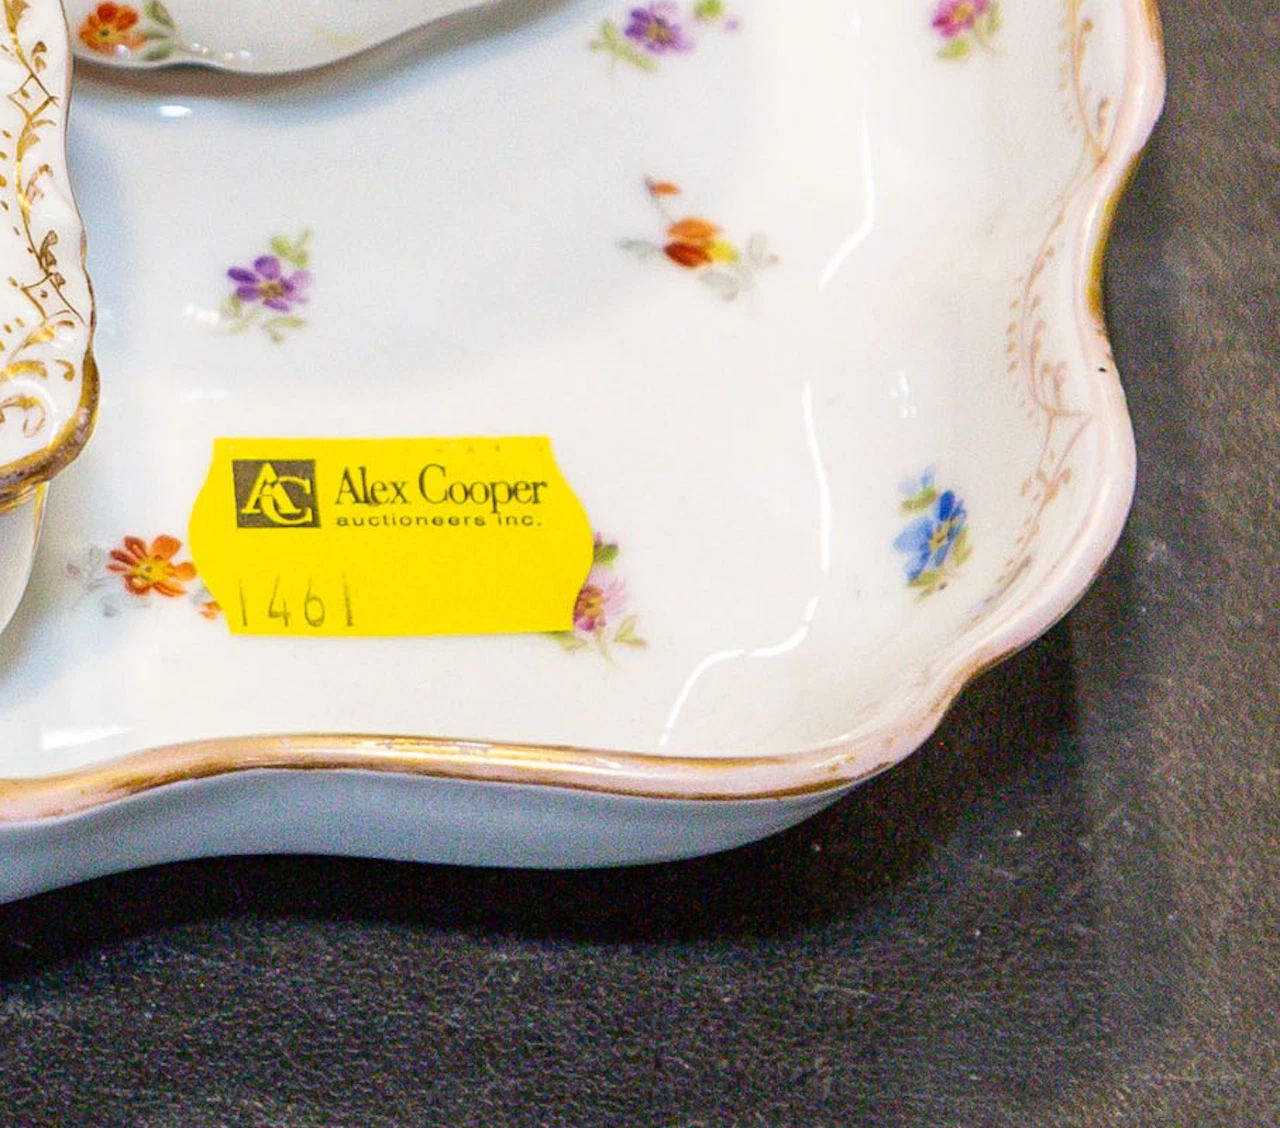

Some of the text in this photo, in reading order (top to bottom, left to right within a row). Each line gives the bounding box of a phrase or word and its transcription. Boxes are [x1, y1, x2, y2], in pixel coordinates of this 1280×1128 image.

[335, 466, 409, 507] Alex
[418, 463, 548, 514] Cooper
[336, 513, 542, 527] auctioneers inc.
[238, 574, 356, 628] 1461
